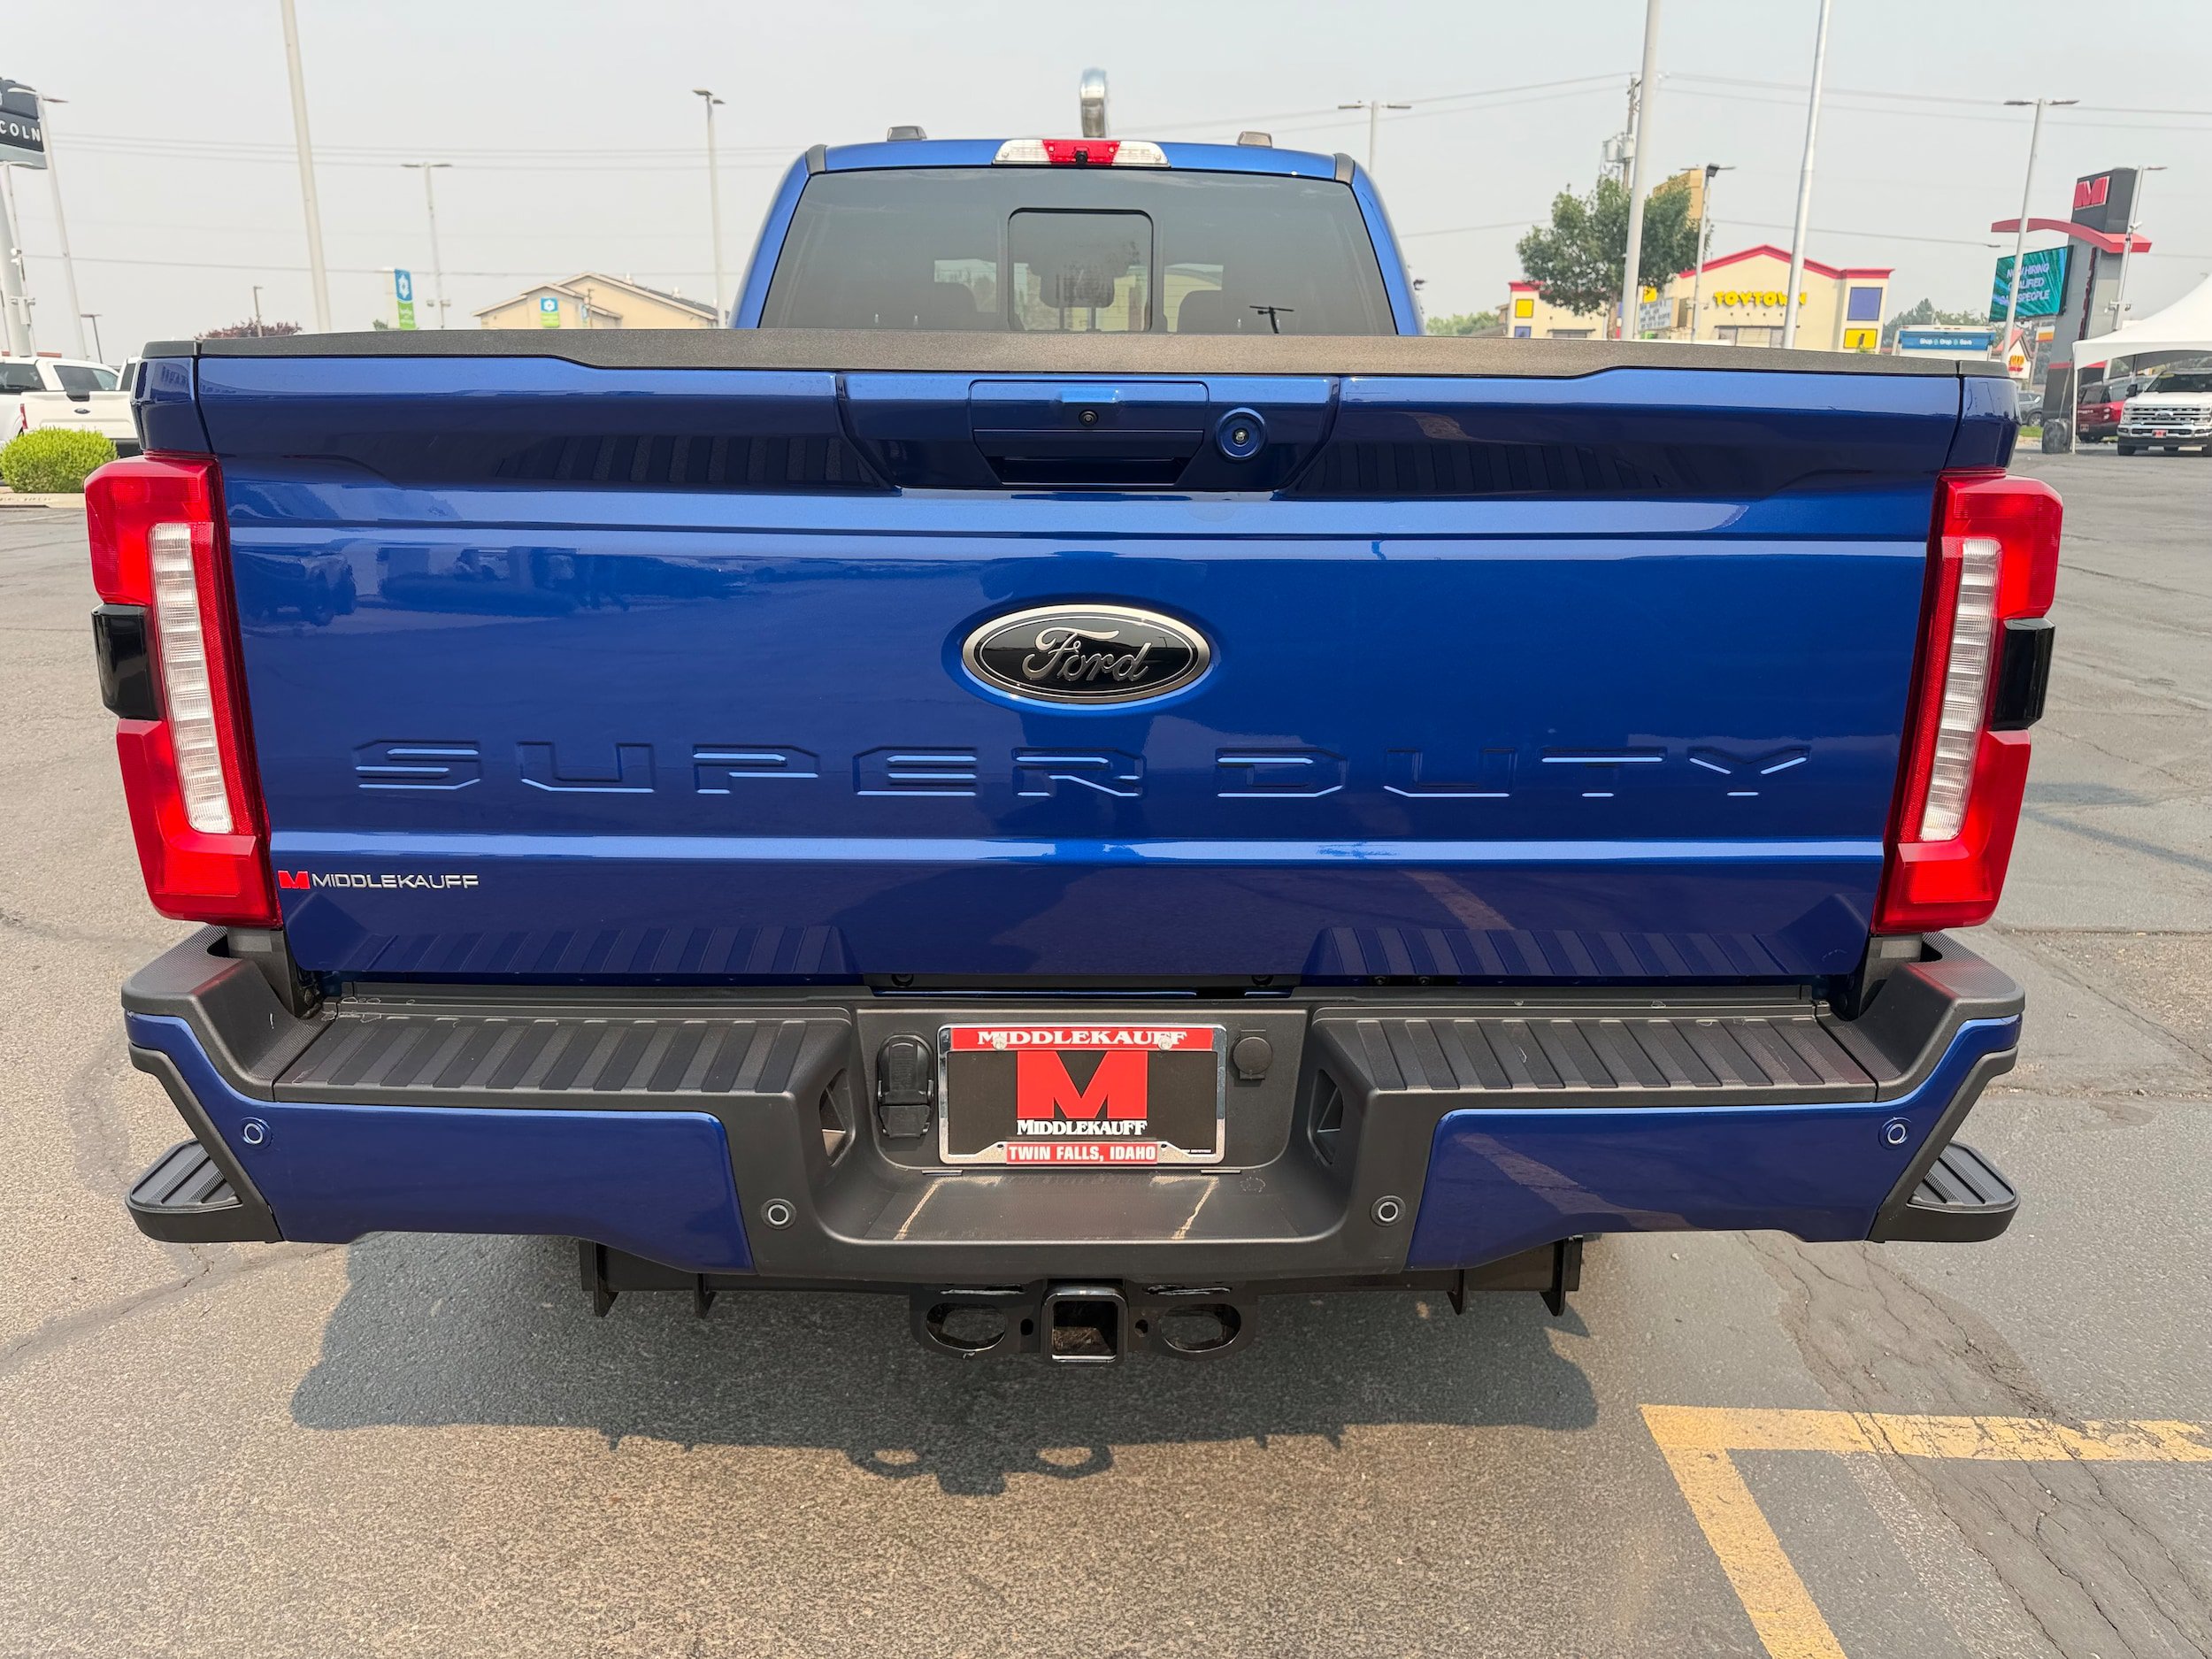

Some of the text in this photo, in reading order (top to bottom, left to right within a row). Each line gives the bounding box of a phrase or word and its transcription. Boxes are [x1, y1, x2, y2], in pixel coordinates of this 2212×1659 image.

[1021, 626, 1152, 681] Ford
[352, 740, 1811, 801] SUPER DUTY
[311, 872, 480, 889] MIDDLEKAUFF
[977, 1030, 1187, 1046] MIDDLEKAUFF
[1016, 1050, 1148, 1119] M
[1016, 1119, 1148, 1137] MIDDLEKAUFF
[1008, 1145, 1156, 1163] TWIN FALLS, IDAHO
